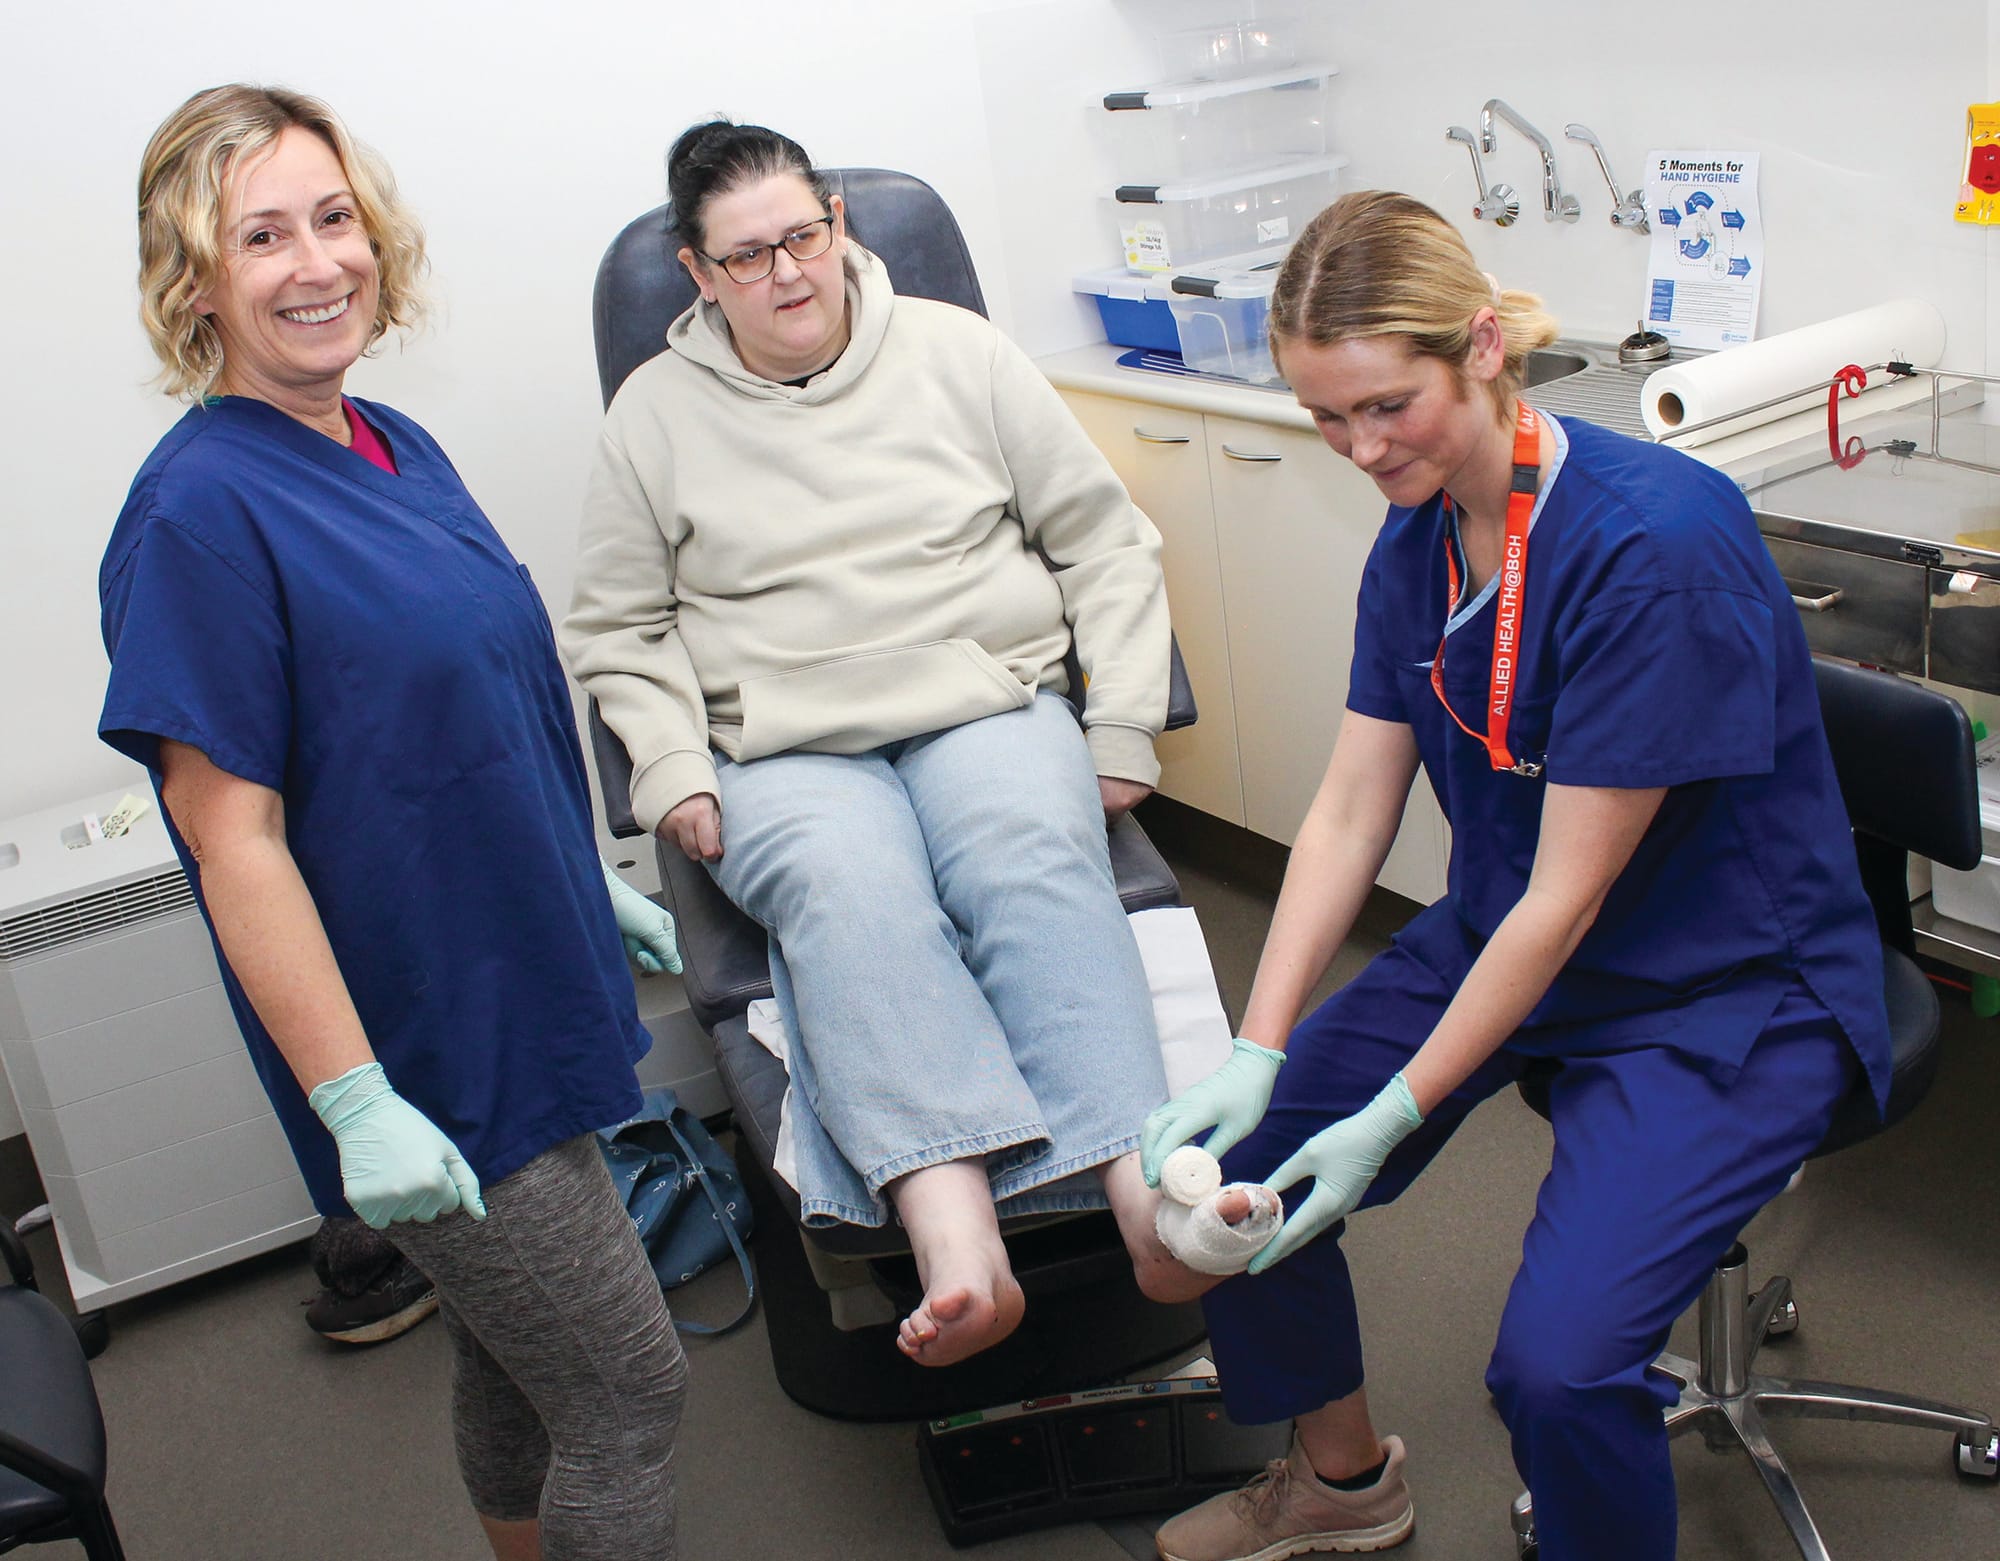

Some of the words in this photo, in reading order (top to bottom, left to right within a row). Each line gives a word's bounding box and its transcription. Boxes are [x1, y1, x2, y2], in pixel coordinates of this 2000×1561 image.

[1659, 160, 1667, 170] 5
[1669, 160, 1723, 171] Moments
[1726, 161, 1744, 172] for
[1660, 172, 1690, 181] HAND
[1692, 173, 1741, 183] HYGIENE
[1498, 535, 1522, 653] HEALTH@BCH
[1493, 657, 1511, 716] ALLIED
